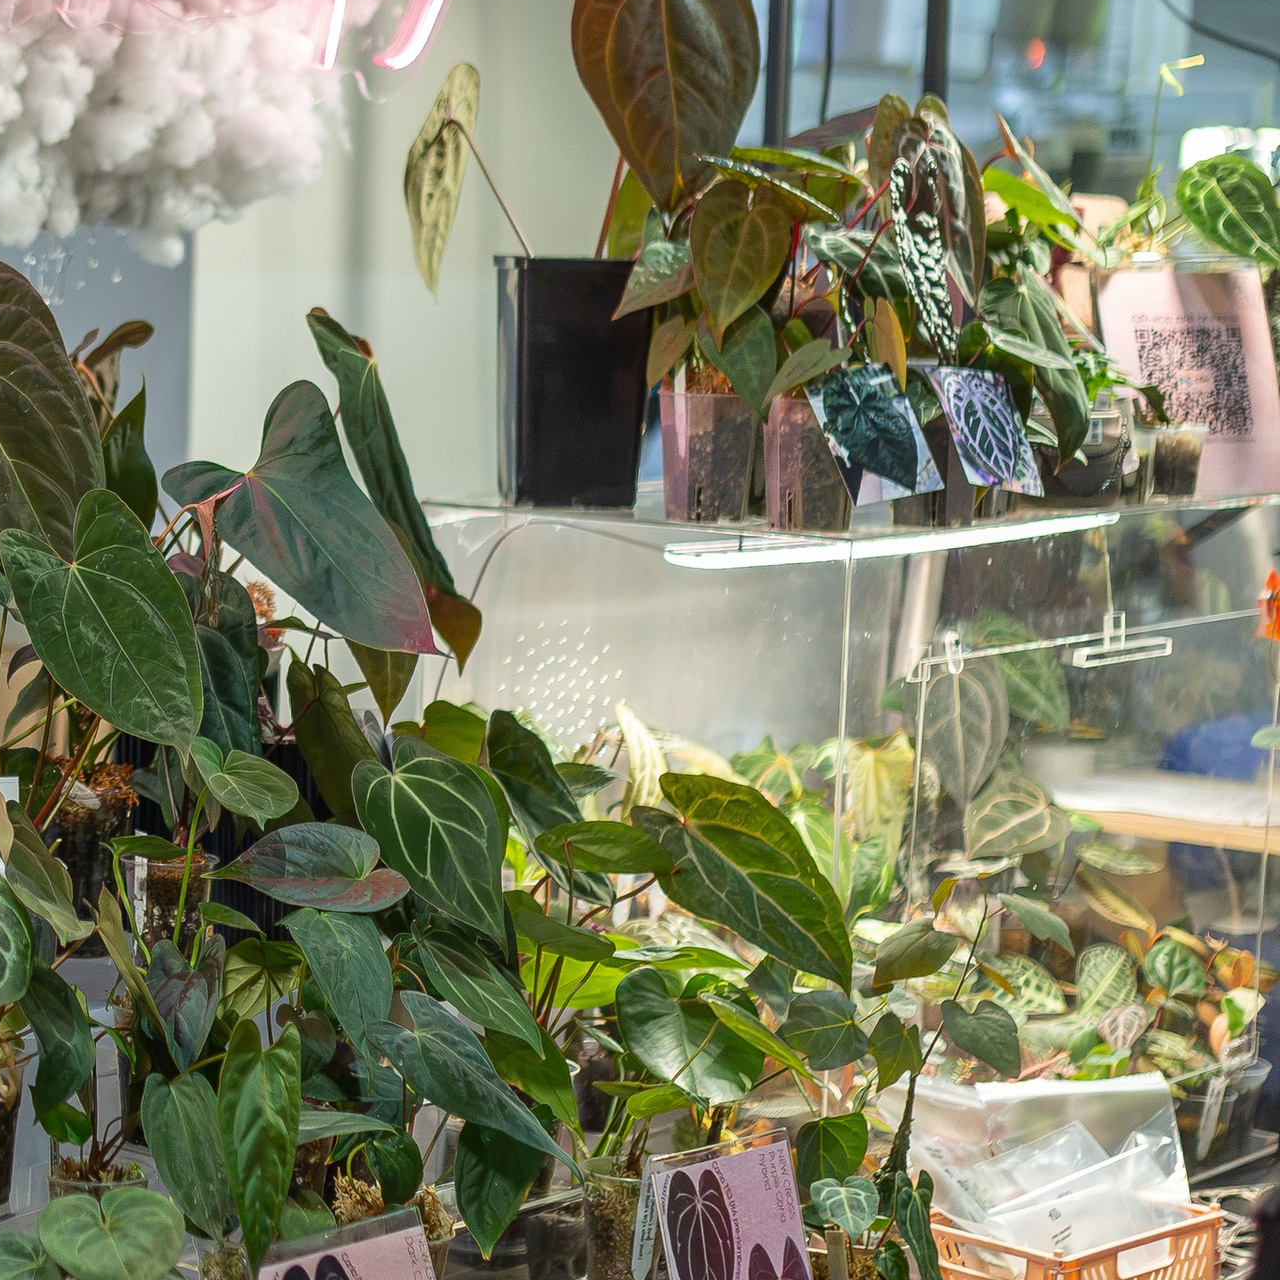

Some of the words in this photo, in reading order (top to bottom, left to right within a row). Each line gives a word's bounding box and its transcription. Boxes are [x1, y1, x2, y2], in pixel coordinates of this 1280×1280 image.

[758, 1152, 771, 1192] hybrid
[767, 1150, 780, 1189] Purple
[774, 1190, 787, 1224] Carla
[775, 1148, 789, 1176] NEW
[782, 1178, 797, 1221] CROSS
